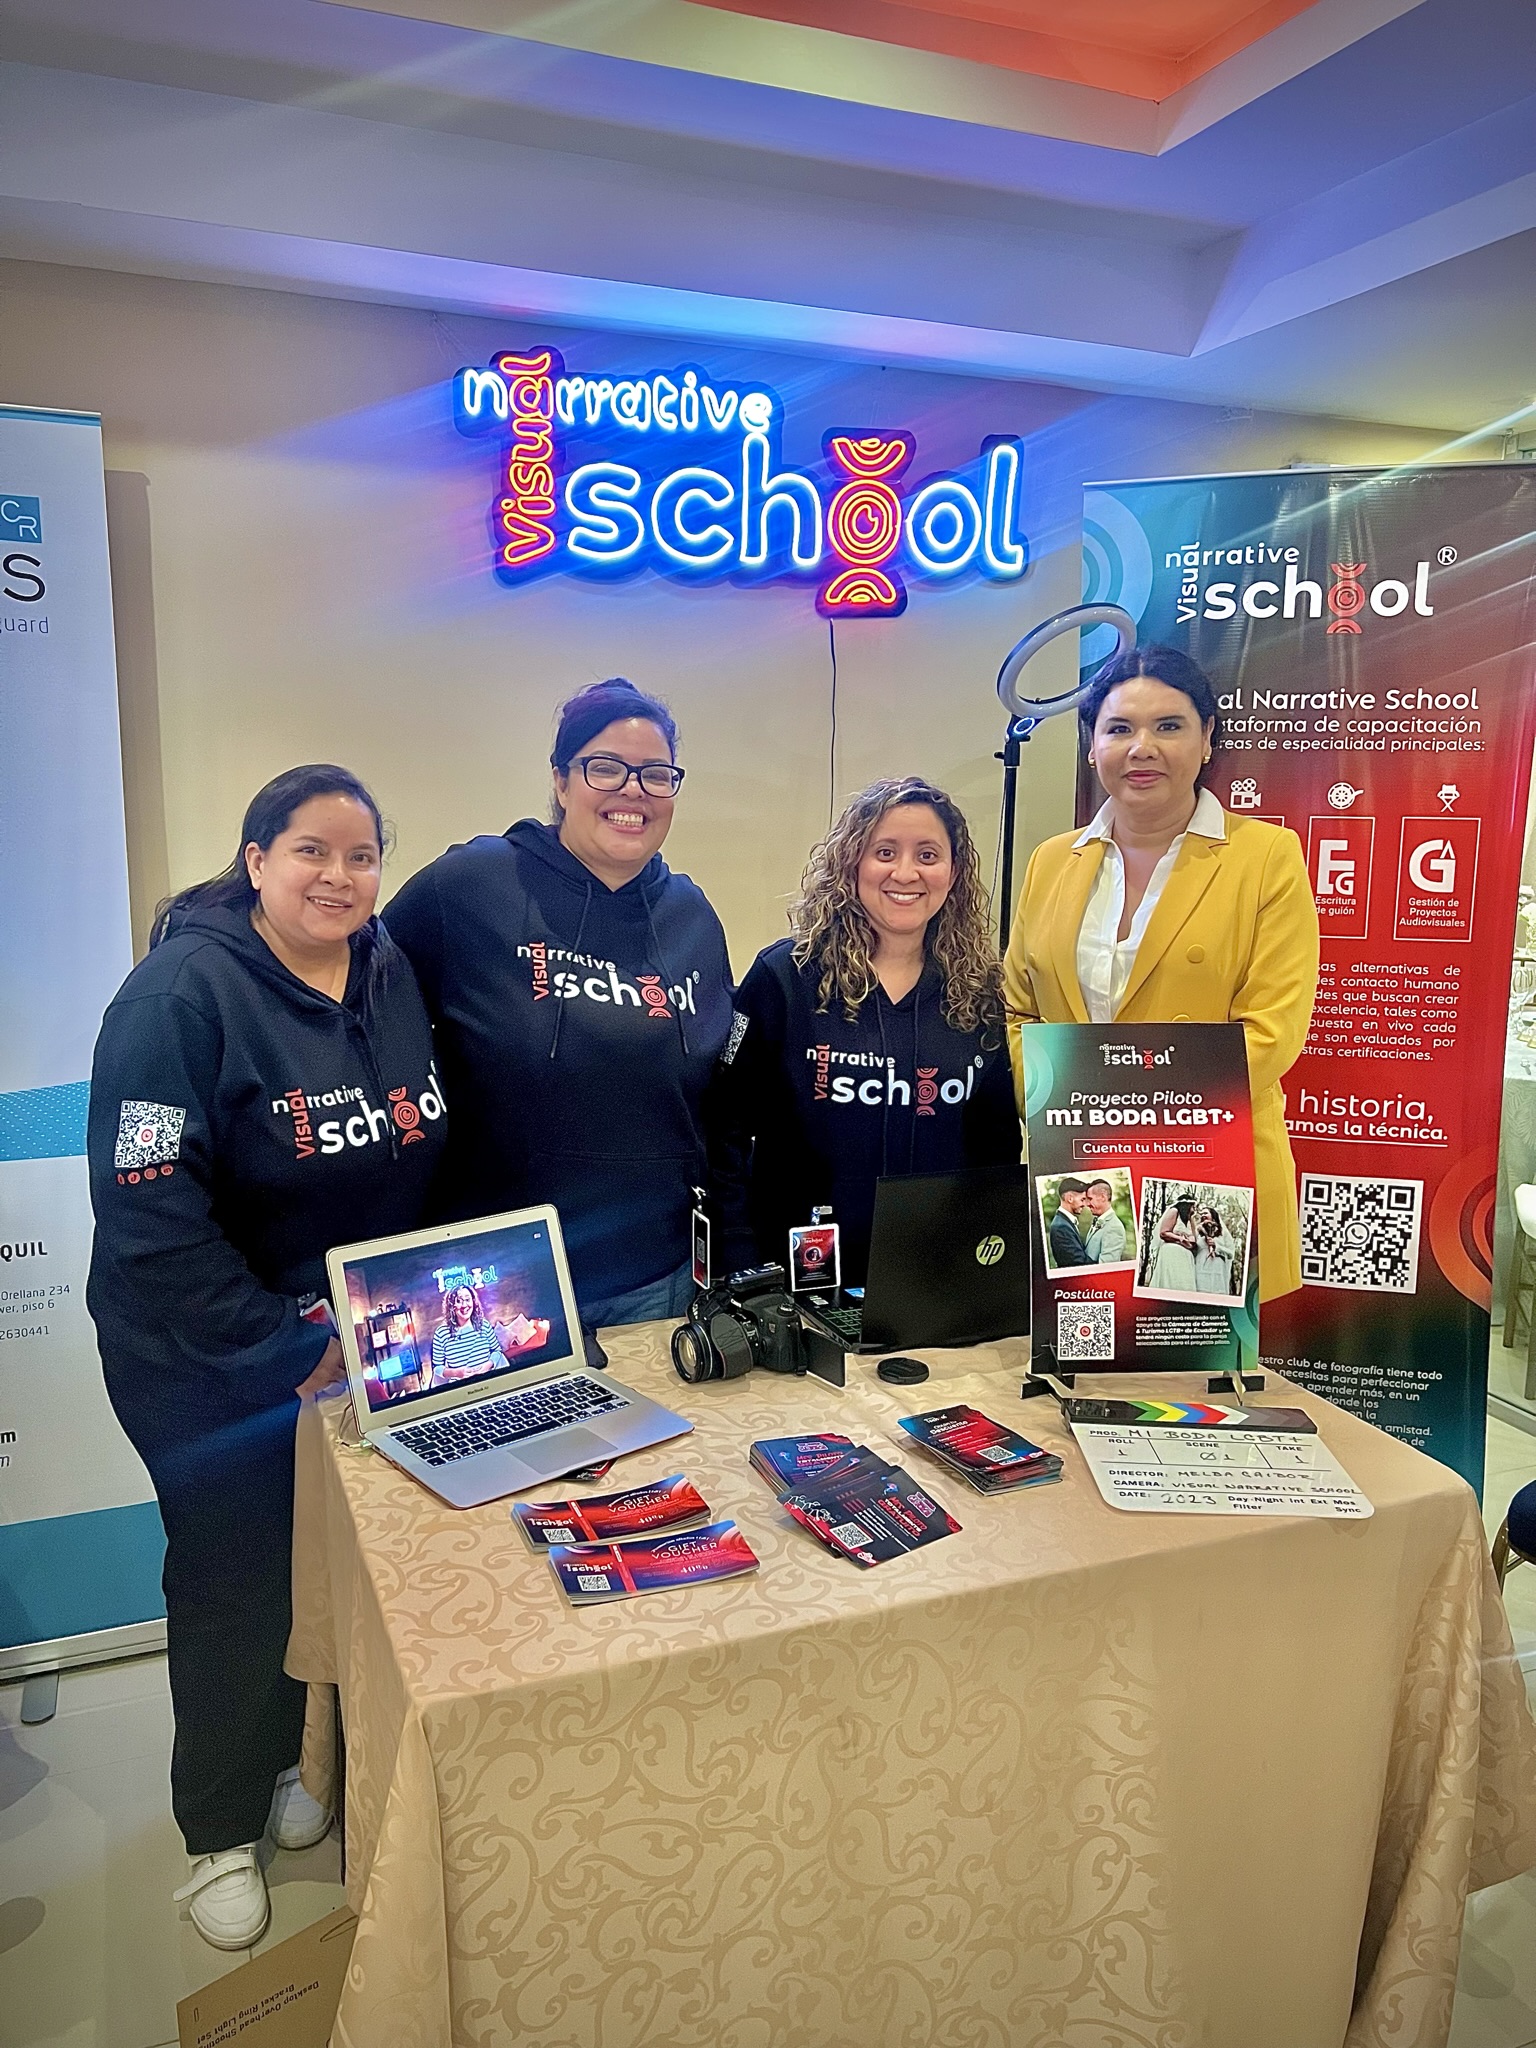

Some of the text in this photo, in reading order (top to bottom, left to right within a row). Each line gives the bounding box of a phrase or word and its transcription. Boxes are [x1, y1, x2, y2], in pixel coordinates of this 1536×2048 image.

[1165, 543, 1300, 568] narrative
[0, 616, 49, 634] uard
[1252, 688, 1375, 710] Narrative
[1384, 687, 1479, 710] School
[1314, 715, 1340, 733] de
[1346, 715, 1482, 737] capacitación
[1257, 736, 1277, 750] de
[1282, 736, 1385, 752] especialidad
[1390, 737, 1486, 752] principales:
[1315, 896, 1356, 905] Escritura
[1409, 897, 1459, 907] Gestión de
[1328, 906, 1355, 916] guión
[1410, 907, 1457, 918] Proyectos
[1399, 917, 1465, 927] Audiovisuales
[1351, 962, 1429, 975] alternativas
[1444, 965, 1461, 976] de
[1341, 977, 1398, 988] contacto
[1404, 978, 1460, 990] humano
[1343, 993, 1367, 1003] que
[1372, 991, 1420, 1004] buscan
[1425, 995, 1459, 1005] crear
[1384, 1006, 1417, 1018] tales
[1420, 1009, 1458, 1019] como
[1362, 1021, 1378, 1030] en
[1387, 1020, 1414, 1031] vivo
[1423, 1021, 1457, 1033] cada
[1324, 1033, 1348, 1043] son
[1353, 1033, 1422, 1046] evaluados
[1432, 1037, 1456, 1049] por
[806, 1048, 896, 1068] narrative
[1337, 1046, 1434, 1061] certificaciones.
[272, 1085, 364, 1114] narrative
[1070, 1090, 1203, 1108] Proyecto Piloto
[1300, 1088, 1434, 1124] historia,
[1089, 1108, 1157, 1126] BODA
[1164, 1108, 1235, 1126] LGBT+
[1343, 1120, 1363, 1136] la
[1368, 1122, 1448, 1141] técnica.
[1082, 1142, 1205, 1154] Cuenta tu historia
[978, 1235, 1005, 1265] hp
[1, 1284, 70, 1301] Orellana 234
[1054, 1289, 1116, 1300] Postúlate
[22, 1302, 44, 1313] piso
[47, 1299, 55, 1309] 6
[1287, 1357, 1310, 1368] club
[1313, 1360, 1328, 1370] de
[1330, 1362, 1384, 1376] fotografía
[1386, 1366, 1414, 1378] tiene
[1417, 1371, 1443, 1381] todo
[1279, 1369, 1429, 1391] necesitas para perfeccionar
[1307, 1383, 1358, 1397] aprender
[1359, 1387, 1386, 1399] más,
[1388, 1391, 1403, 1400] en
[1405, 1393, 1420, 1401] un
[1363, 1398, 1379, 1409] los
[1366, 1410, 1377, 1420] la
[1164, 1430, 1217, 1439] BODA
[1385, 1424, 1433, 1437] amistad.
[1411, 1436, 1425, 1447] de
[1108, 1469, 1168, 1477] DIRECTOR:
[1161, 1493, 1217, 1505] 2023
[284, 1981, 319, 2005] Desktop
[196, 1984, 295, 2044] Bracket Ring Light Set
[239, 2002, 282, 2032] Overhead
